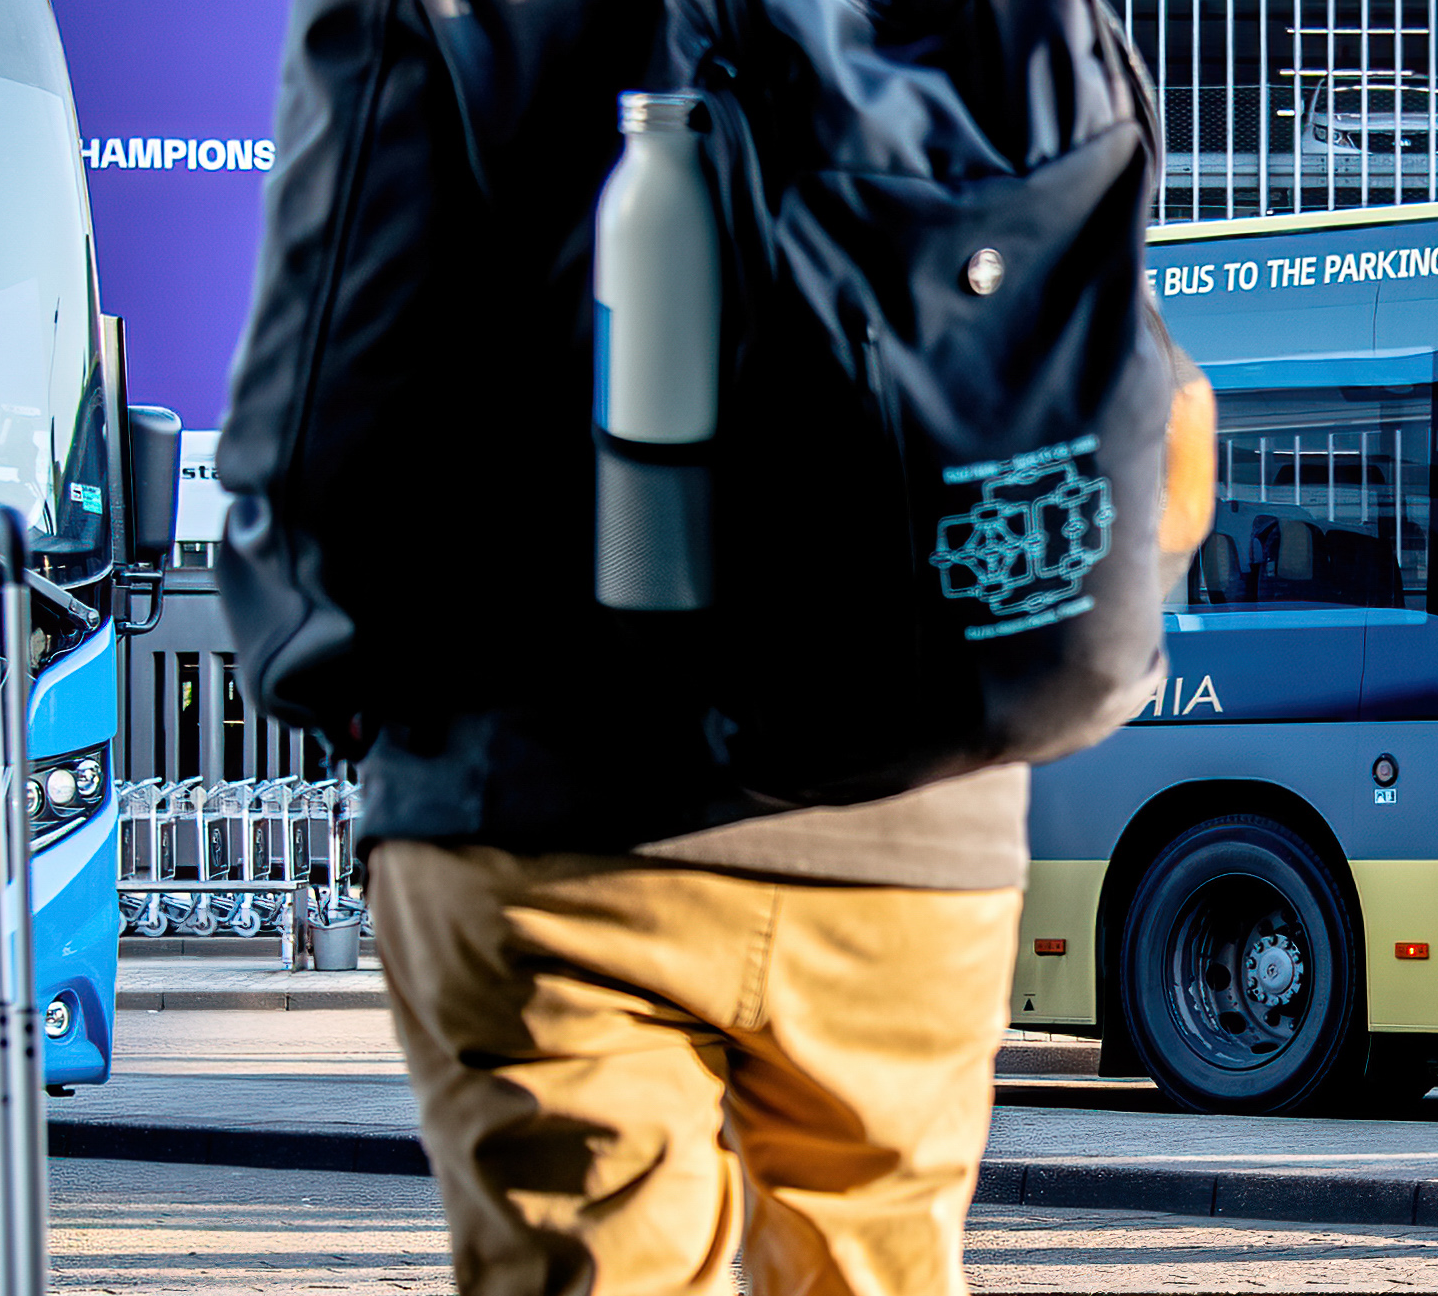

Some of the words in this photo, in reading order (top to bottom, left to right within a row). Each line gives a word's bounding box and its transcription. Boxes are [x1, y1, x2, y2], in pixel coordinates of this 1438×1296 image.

[79, 138, 276, 170] HAMPIONS
[1164, 265, 1215, 296] BUS
[1224, 261, 1259, 292] TO
[1267, 256, 1317, 288] THE
